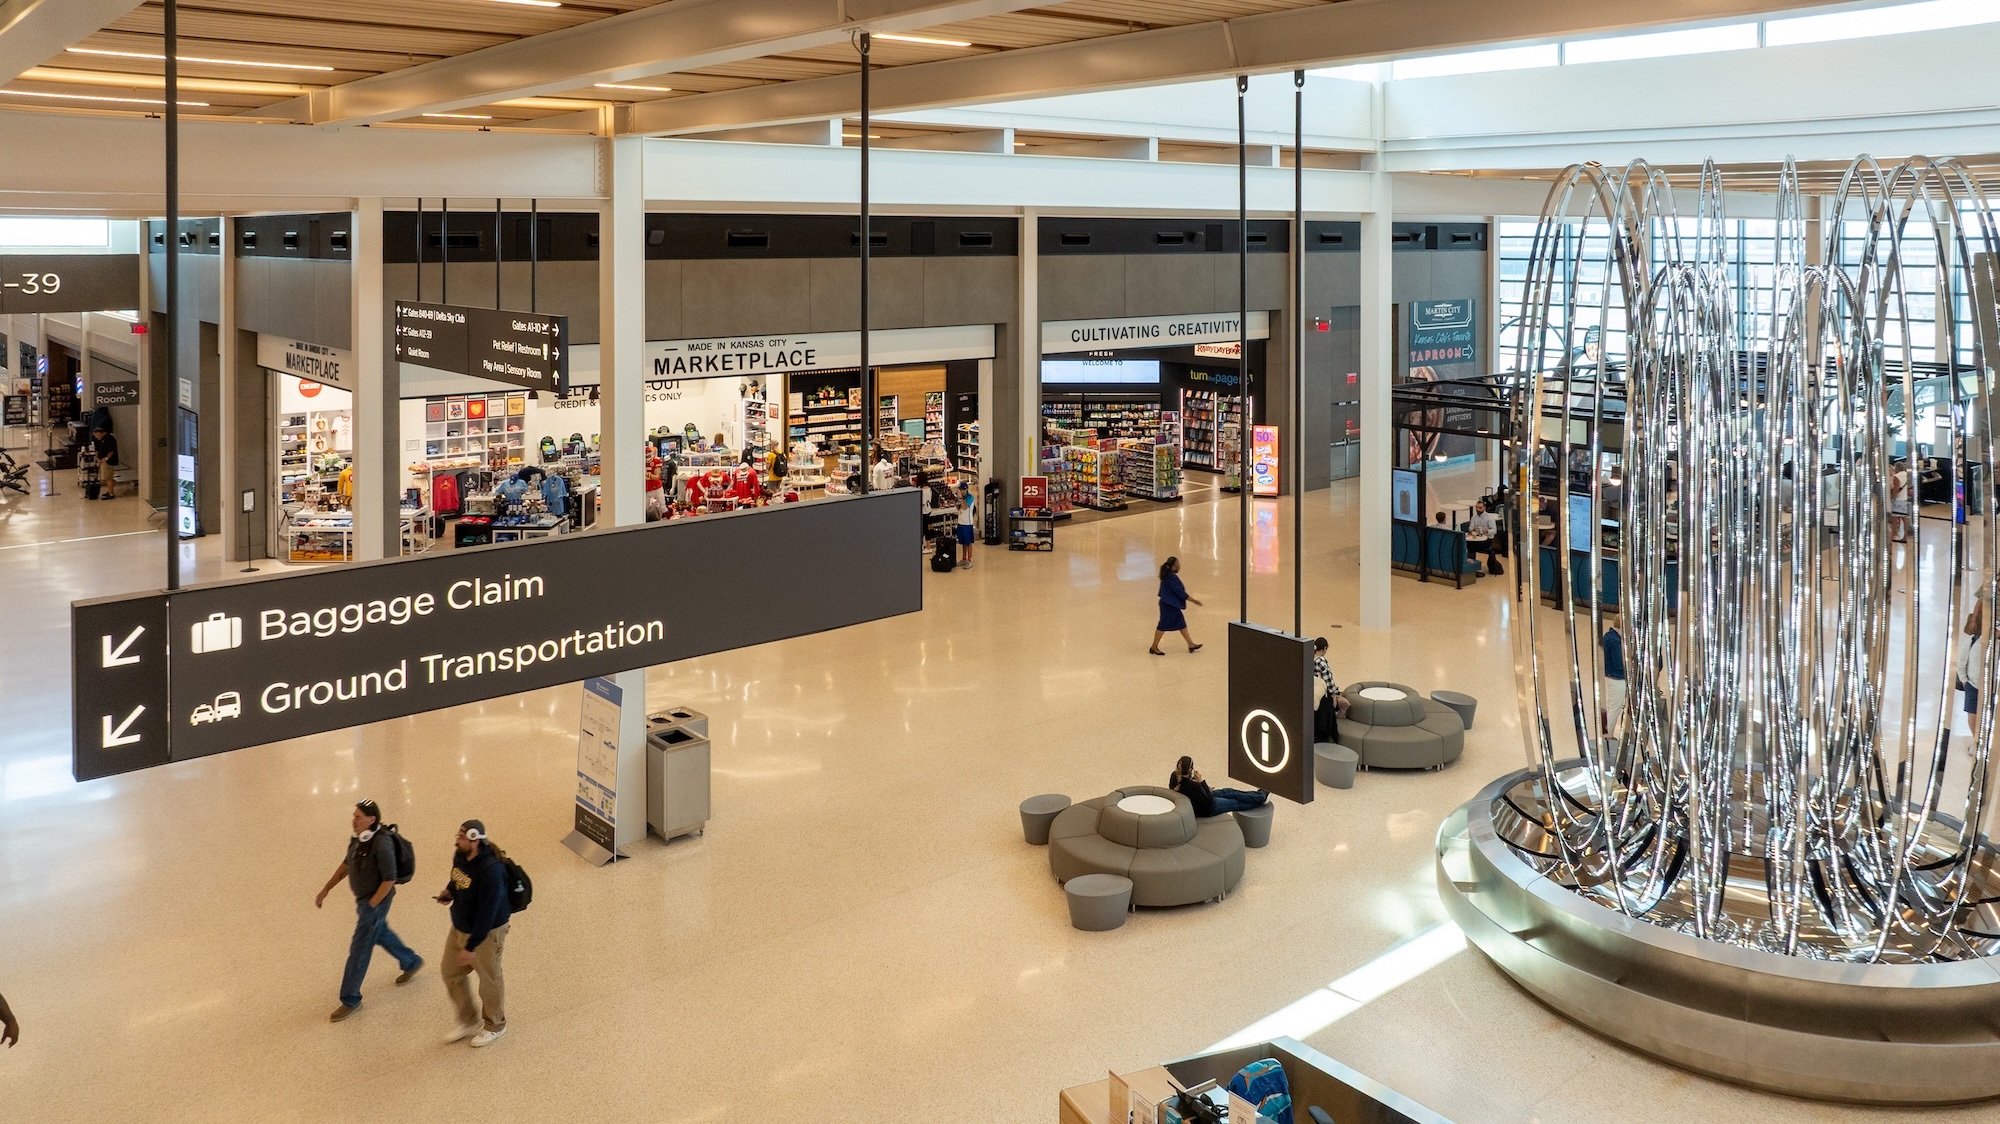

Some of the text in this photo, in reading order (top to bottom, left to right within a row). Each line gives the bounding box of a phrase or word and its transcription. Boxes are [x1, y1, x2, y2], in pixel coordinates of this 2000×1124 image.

[0, 273, 61, 295] -39
[408, 308, 419, 318] Gates
[435, 311, 446, 321] Delta
[446, 312, 455, 324] Sky
[455, 313, 466, 324] Club
[1425, 305, 1461, 315] MARTIN CITY
[408, 327, 419, 337] Gates
[512, 320, 527, 332] Gates
[1071, 320, 1240, 343] CULTIVATING CREATIVITY
[688, 339, 787, 352] MADE IN KANSAS CITY
[1414, 334, 1434, 346] Kansas
[408, 347, 430, 359] Quiet Room
[492, 340, 542, 356] Pet Relief Restroom
[1214, 346, 1225, 354] Day
[1410, 347, 1461, 362] TAPROOM
[286, 351, 339, 381] MARKETPLACE
[483, 359, 542, 379] Play Area Sensory Room
[654, 349, 816, 376] MARKETPLACE
[1215, 373, 1238, 386] page
[97, 385, 126, 394] Quiet
[96, 396, 126, 404] Room
[659, 392, 682, 401] ONLY
[554, 399, 597, 409] CREDIT &
[1446, 413, 1472, 422] APPETIZERS
[260, 575, 545, 642] Baggage Claim
[260, 620, 665, 714] Ground Transportation
